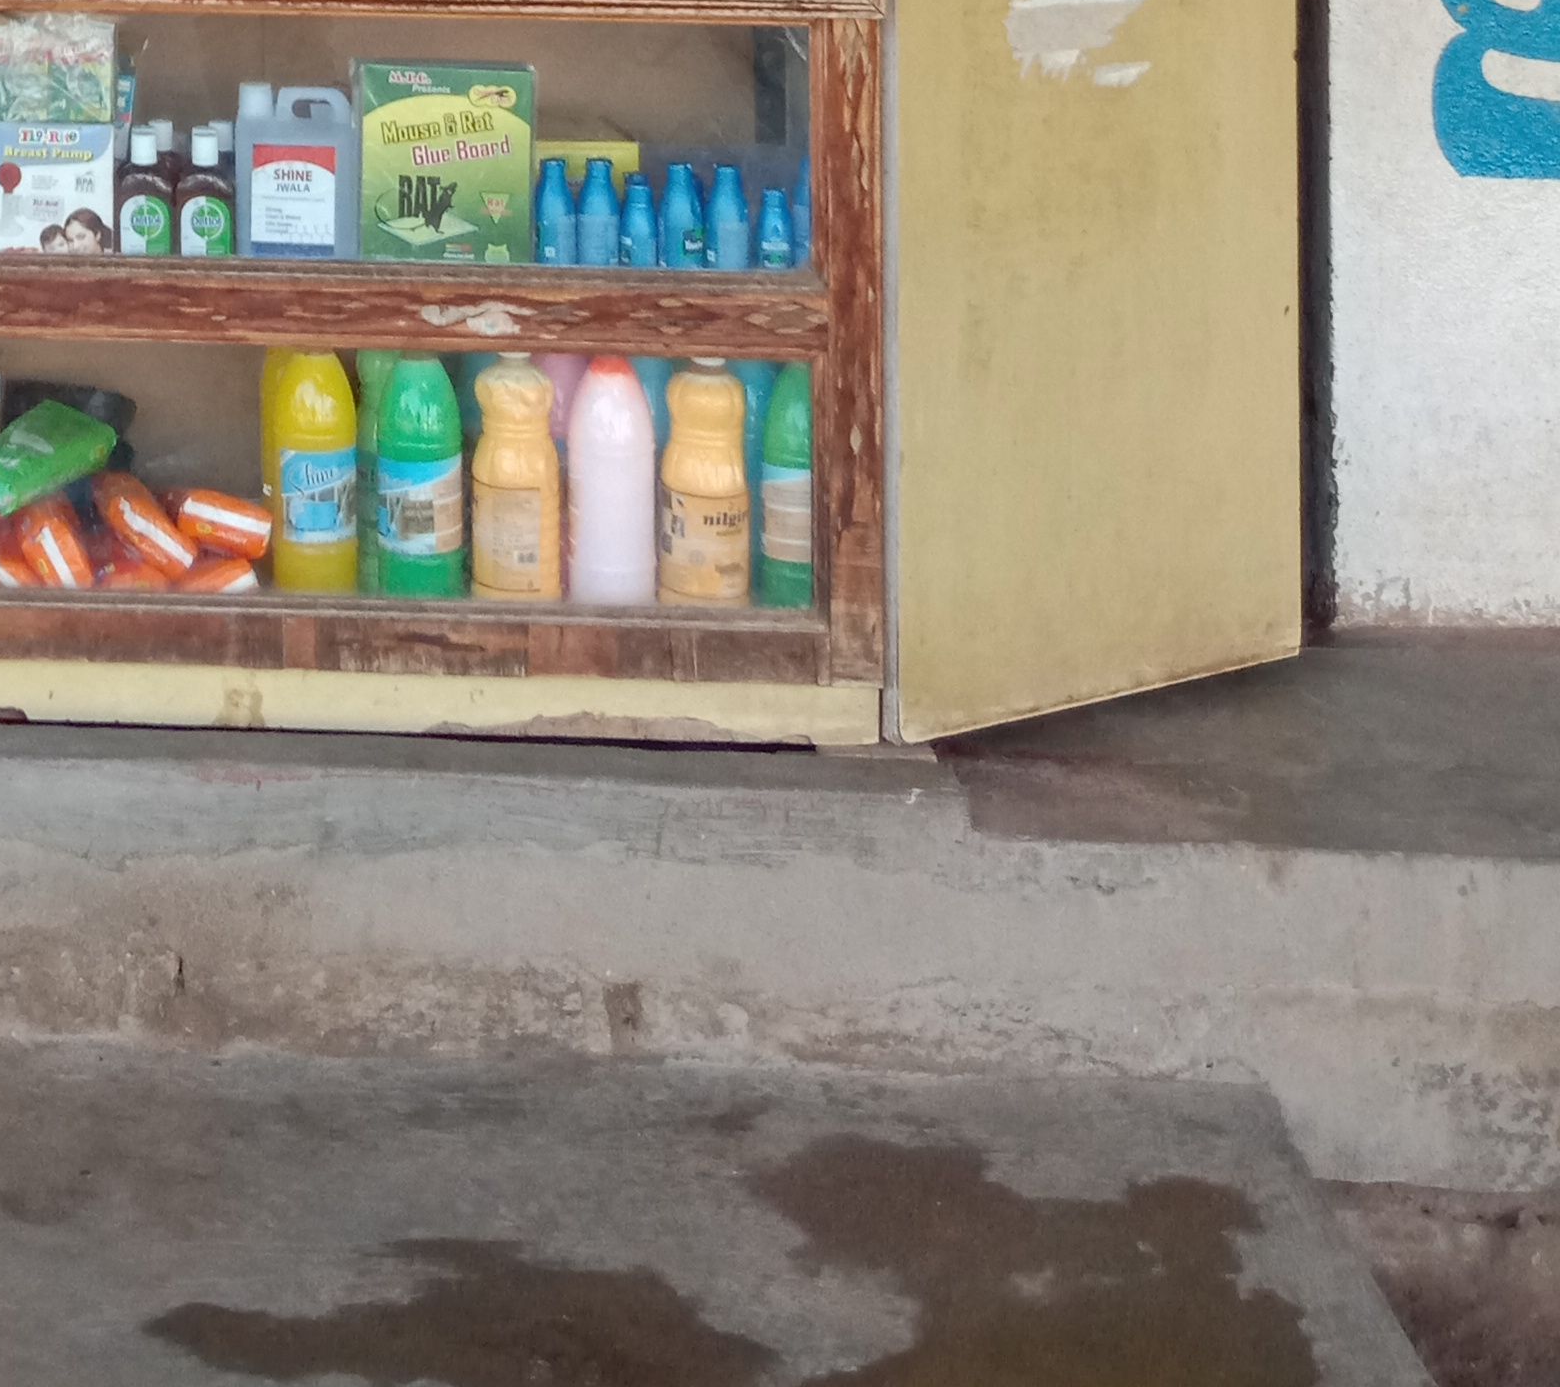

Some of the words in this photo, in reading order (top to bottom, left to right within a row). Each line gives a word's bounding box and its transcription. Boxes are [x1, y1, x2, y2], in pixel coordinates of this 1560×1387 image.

[380, 120, 441, 145] Mouse
[460, 111, 495, 134] Rat
[51, 146, 94, 162] Pump
[411, 145, 451, 166] Glue
[455, 133, 511, 161] Board
[273, 168, 313, 183] SHINE
[275, 183, 311, 194] JWALA
[398, 174, 441, 218] RAT
